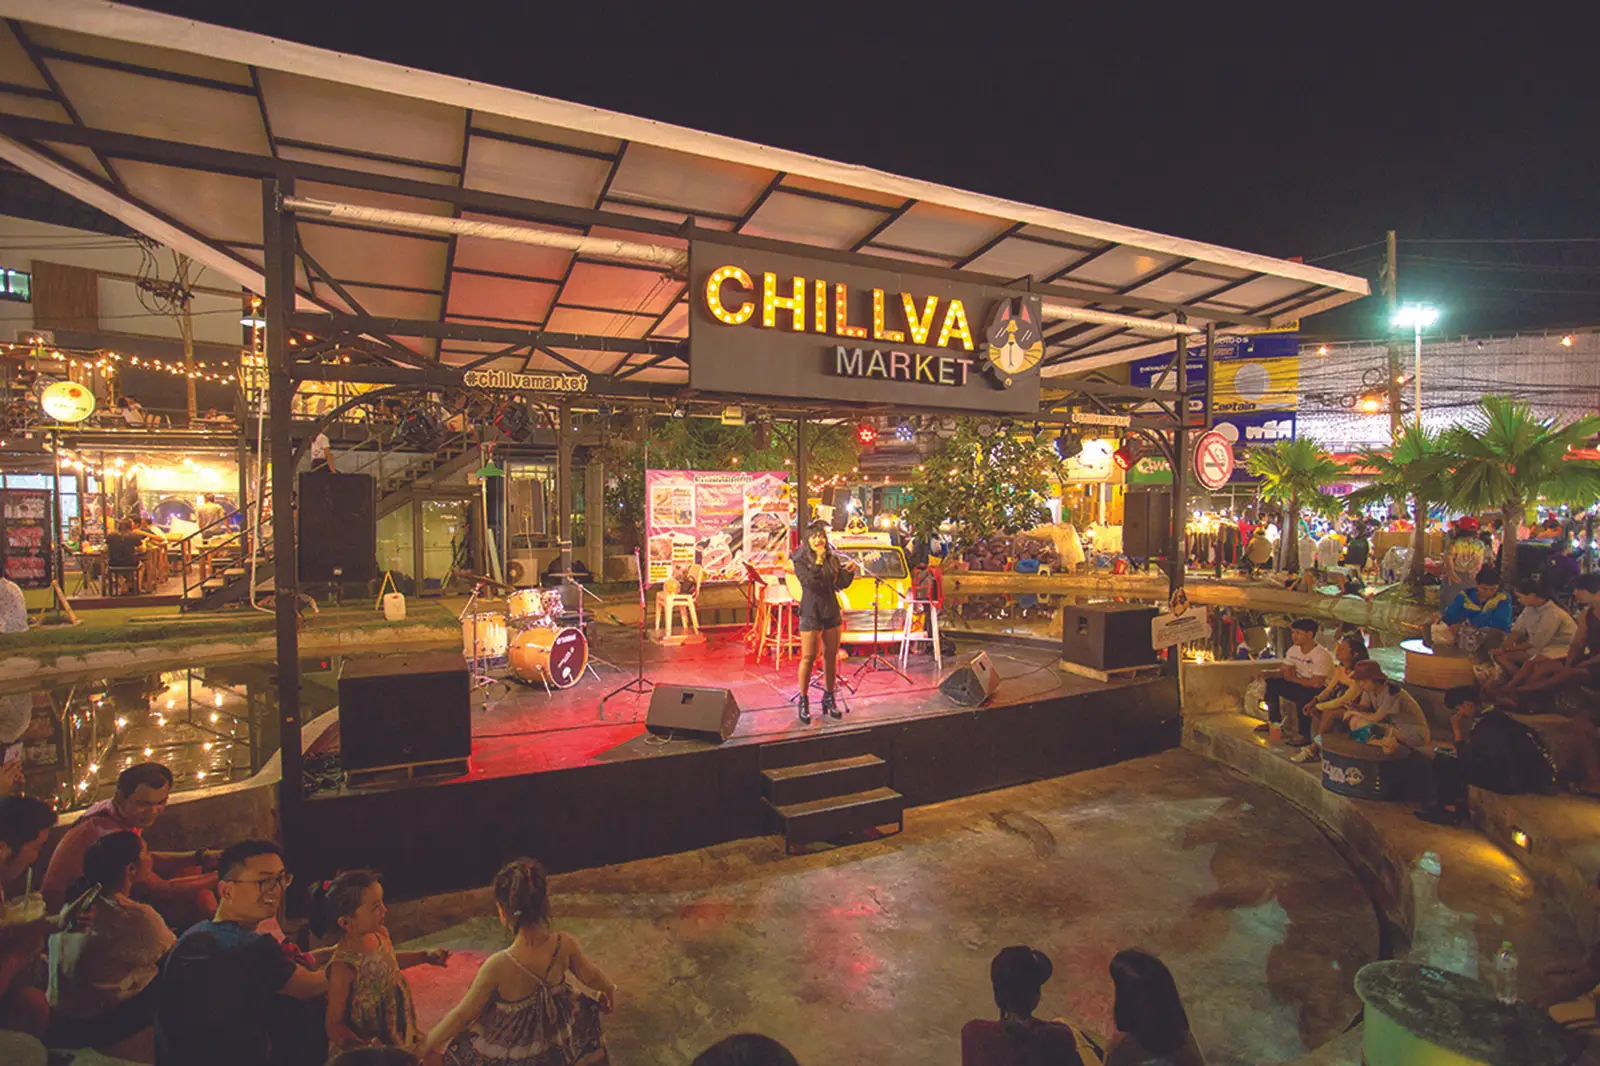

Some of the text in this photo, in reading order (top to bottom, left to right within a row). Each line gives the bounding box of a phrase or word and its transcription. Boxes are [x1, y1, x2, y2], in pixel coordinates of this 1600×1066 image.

[705, 265, 975, 351] CHILLVA
[465, 370, 588, 392] #chillvamarket
[836, 346, 975, 386] MARKET
